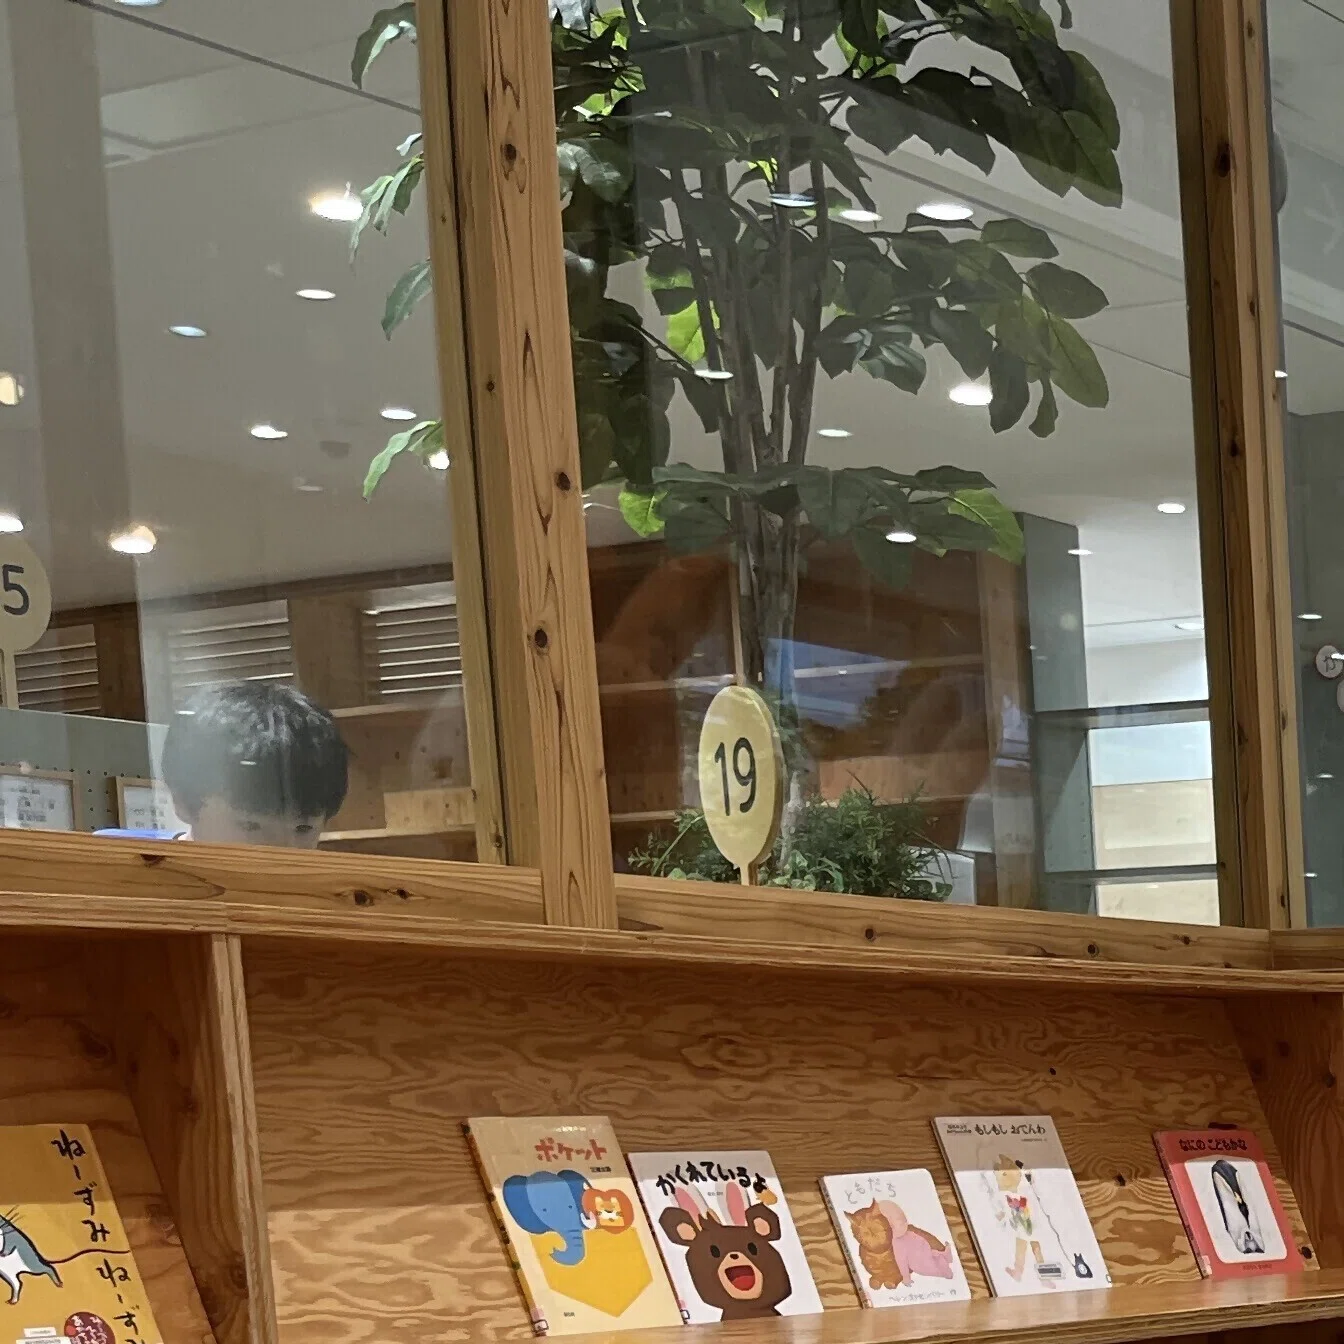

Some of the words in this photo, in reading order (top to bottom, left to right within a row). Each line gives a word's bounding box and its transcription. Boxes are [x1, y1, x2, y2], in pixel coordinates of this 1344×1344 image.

[714, 736, 757, 817] 19
[975, 1123, 1008, 1135] もしもし
[534, 1137, 607, 1162] ポケット
[50, 1128, 110, 1242] ねーずみ
[655, 1160, 768, 1196] かくれているよ
[844, 1177, 897, 1204] ともだち
